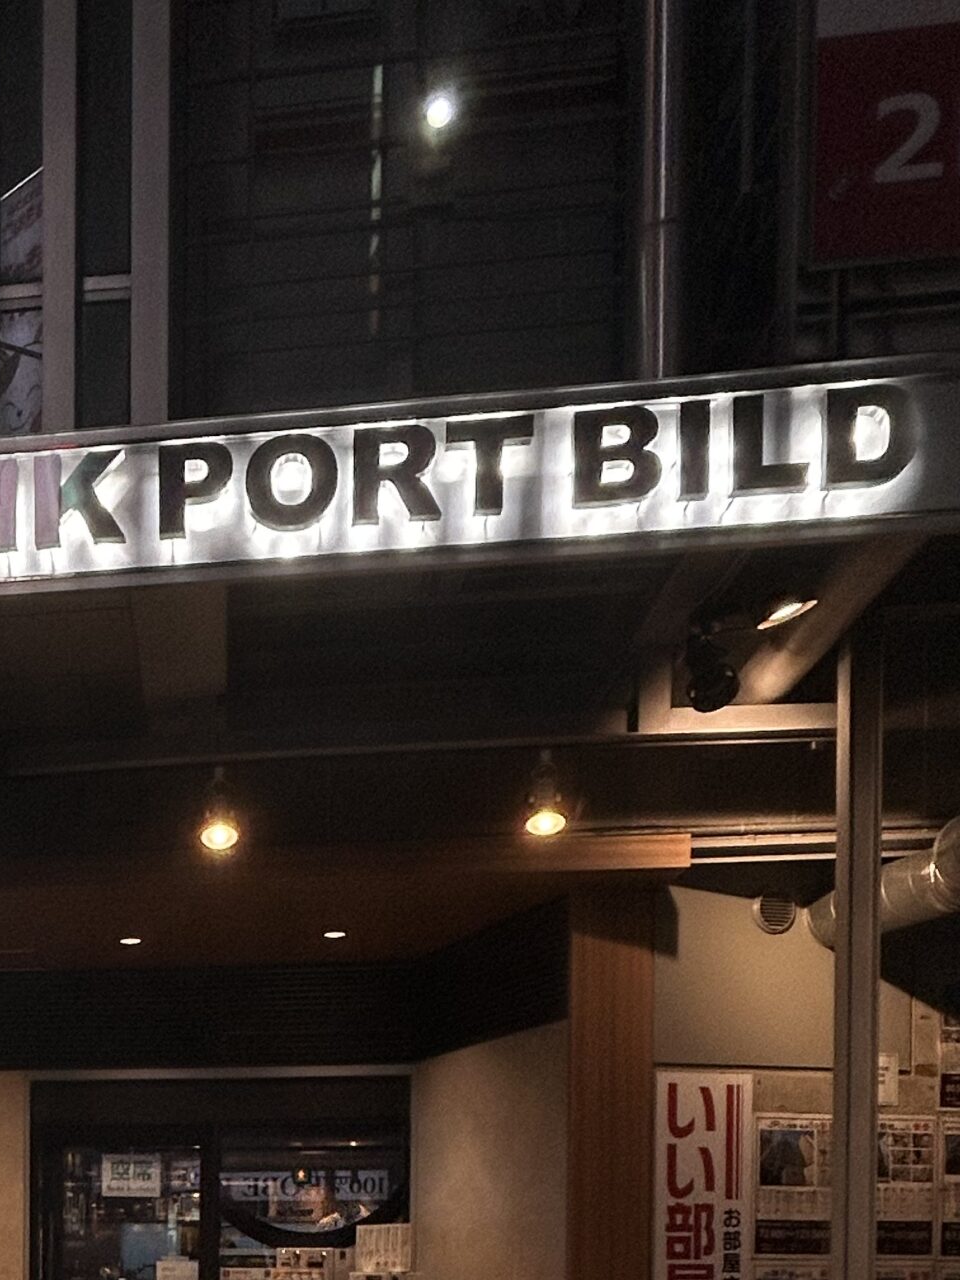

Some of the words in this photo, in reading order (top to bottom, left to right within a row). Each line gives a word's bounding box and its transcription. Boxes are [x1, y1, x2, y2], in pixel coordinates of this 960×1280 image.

[874, 92, 944, 183] 2
[158, 414, 534, 541] PORT
[572, 383, 918, 510] BILD
